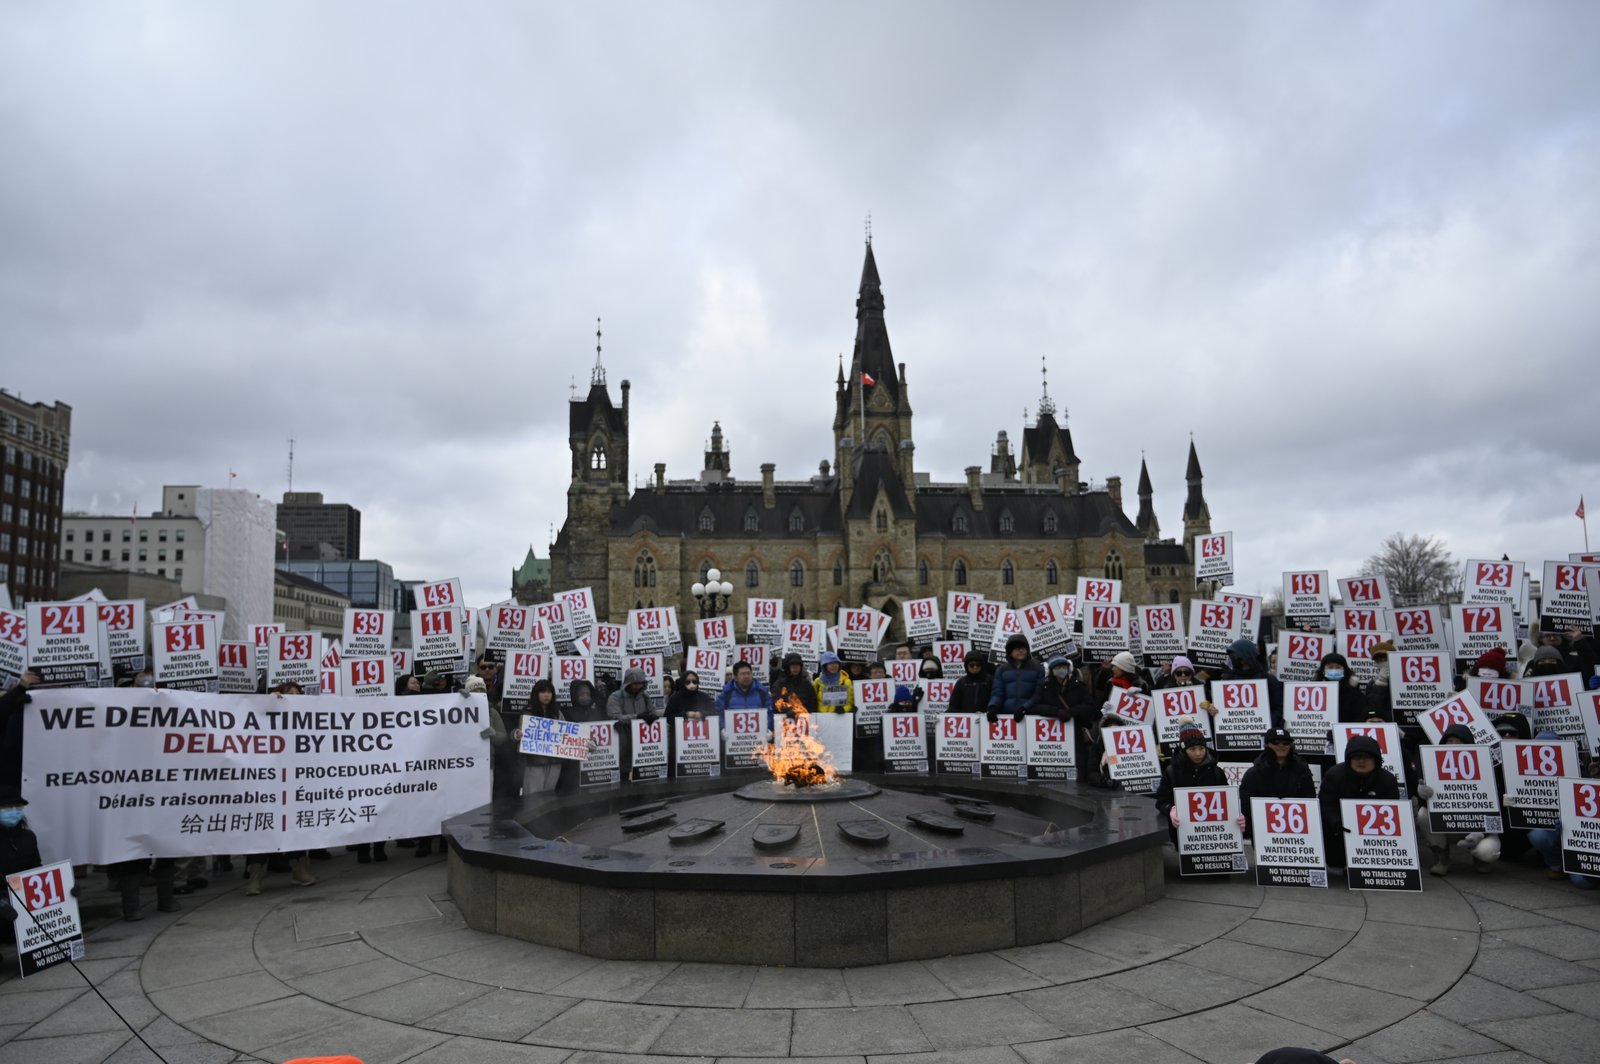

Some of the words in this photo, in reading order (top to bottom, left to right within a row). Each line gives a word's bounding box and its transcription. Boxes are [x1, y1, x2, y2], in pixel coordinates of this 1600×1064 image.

[1204, 537, 1223, 557] 43
[1296, 575, 1315, 593] 19
[1480, 564, 1507, 586] 23
[427, 584, 451, 605] 43
[1088, 582, 1109, 600] 32
[1352, 580, 1373, 600] 27
[102, 606, 130, 630] 23
[501, 609, 523, 629] 39
[758, 602, 774, 617] 19
[913, 602, 930, 618] 19
[979, 605, 997, 623] 38
[1030, 604, 1051, 627] 13
[1096, 608, 1118, 627] 70
[1150, 609, 1171, 630] 68
[1204, 605, 1229, 628] 53
[46, 607, 80, 633] 24
[356, 613, 381, 634] 39
[426, 613, 447, 635] 11
[640, 612, 658, 629] 34
[707, 622, 724, 638] 16
[848, 613, 868, 630] 42
[1349, 611, 1371, 630] 37
[1400, 611, 1428, 634] 23
[1467, 608, 1496, 632] 72
[46, 637, 81, 645] MONTHS
[171, 625, 200, 651] 31
[601, 627, 618, 646] 39
[792, 625, 810, 641] 42
[38, 646, 72, 654] WAITING
[52, 653, 94, 661] RESPONSE
[223, 645, 243, 667] 11
[284, 636, 308, 659] 53
[743, 648, 761, 664] 30
[943, 645, 963, 663] 32
[1291, 637, 1318, 660] 28
[517, 655, 538, 675] 40
[565, 660, 584, 679] 39
[699, 651, 718, 668] 30
[1406, 657, 1435, 682] 65
[356, 661, 379, 685] 19
[894, 664, 914, 681] 30
[864, 684, 886, 702] 34
[931, 684, 951, 701] 55
[1227, 685, 1254, 708] 30
[1297, 688, 1323, 711] 90
[1484, 683, 1516, 710] 40
[1536, 681, 1567, 706] 41
[1119, 697, 1143, 719] 23
[1167, 692, 1194, 714] 30
[41, 707, 95, 730] WE
[106, 707, 235, 729] DEMAND
[244, 712, 260, 730] A
[267, 712, 355, 730] TIMELY
[363, 707, 479, 729] DECISION
[529, 717, 554, 730] STOP
[558, 722, 579, 735] THE
[737, 714, 759, 733] 35
[897, 718, 916, 737] 51
[947, 718, 969, 737] 34
[591, 725, 609, 745] 39
[642, 722, 659, 743] 36
[687, 721, 706, 740] 11
[993, 720, 1014, 739] 31
[1038, 720, 1062, 740] 34
[163, 733, 285, 754] DELAYED
[295, 735, 325, 753] BY
[333, 734, 393, 752] IRCC
[1118, 731, 1142, 752] 42
[1441, 751, 1475, 779] 40
[1522, 746, 1557, 775] 18
[46, 768, 178, 787] REASONABLE
[183, 768, 276, 781] TIMELINES
[295, 762, 401, 779] PROCEDURAL
[406, 757, 474, 772] FAIRNESS
[99, 793, 155, 809] Délais
[161, 791, 276, 808] raisonnables
[296, 785, 343, 803] Équité
[349, 780, 437, 800] procédurale
[1192, 793, 1223, 821] 34
[180, 812, 274, 834] 给出时限
[296, 805, 378, 829] 程序公平
[1270, 804, 1304, 833] 36
[1362, 806, 1396, 835] 23
[1187, 834, 1217, 842] WAITING
[1194, 825, 1225, 833] MONTHS
[1183, 843, 1200, 851] IRCC
[1201, 842, 1238, 851] RESPONSE
[1264, 846, 1298, 854] WAITING
[1272, 837, 1305, 845] MONTHS
[1363, 838, 1397, 847] MONTHS
[1201, 854, 1232, 862] TIMELINES
[1278, 855, 1320, 864] RESPONSE
[1352, 857, 1369, 865] IRCC
[1370, 857, 1413, 866] RESPONSE
[1355, 848, 1390, 856] WAITING
[1391, 848, 1407, 856] FOR
[1371, 871, 1407, 879] TIMELINES
[29, 872, 61, 909] 31
[26, 920, 56, 936] WAITING
[58, 915, 72, 926] FOR
[33, 908, 62, 924] MONTHS
[23, 936, 42, 948] IRCC
[41, 924, 76, 942] RESPONSE
[33, 951, 41, 960] NO
[37, 959, 45, 967] NO
